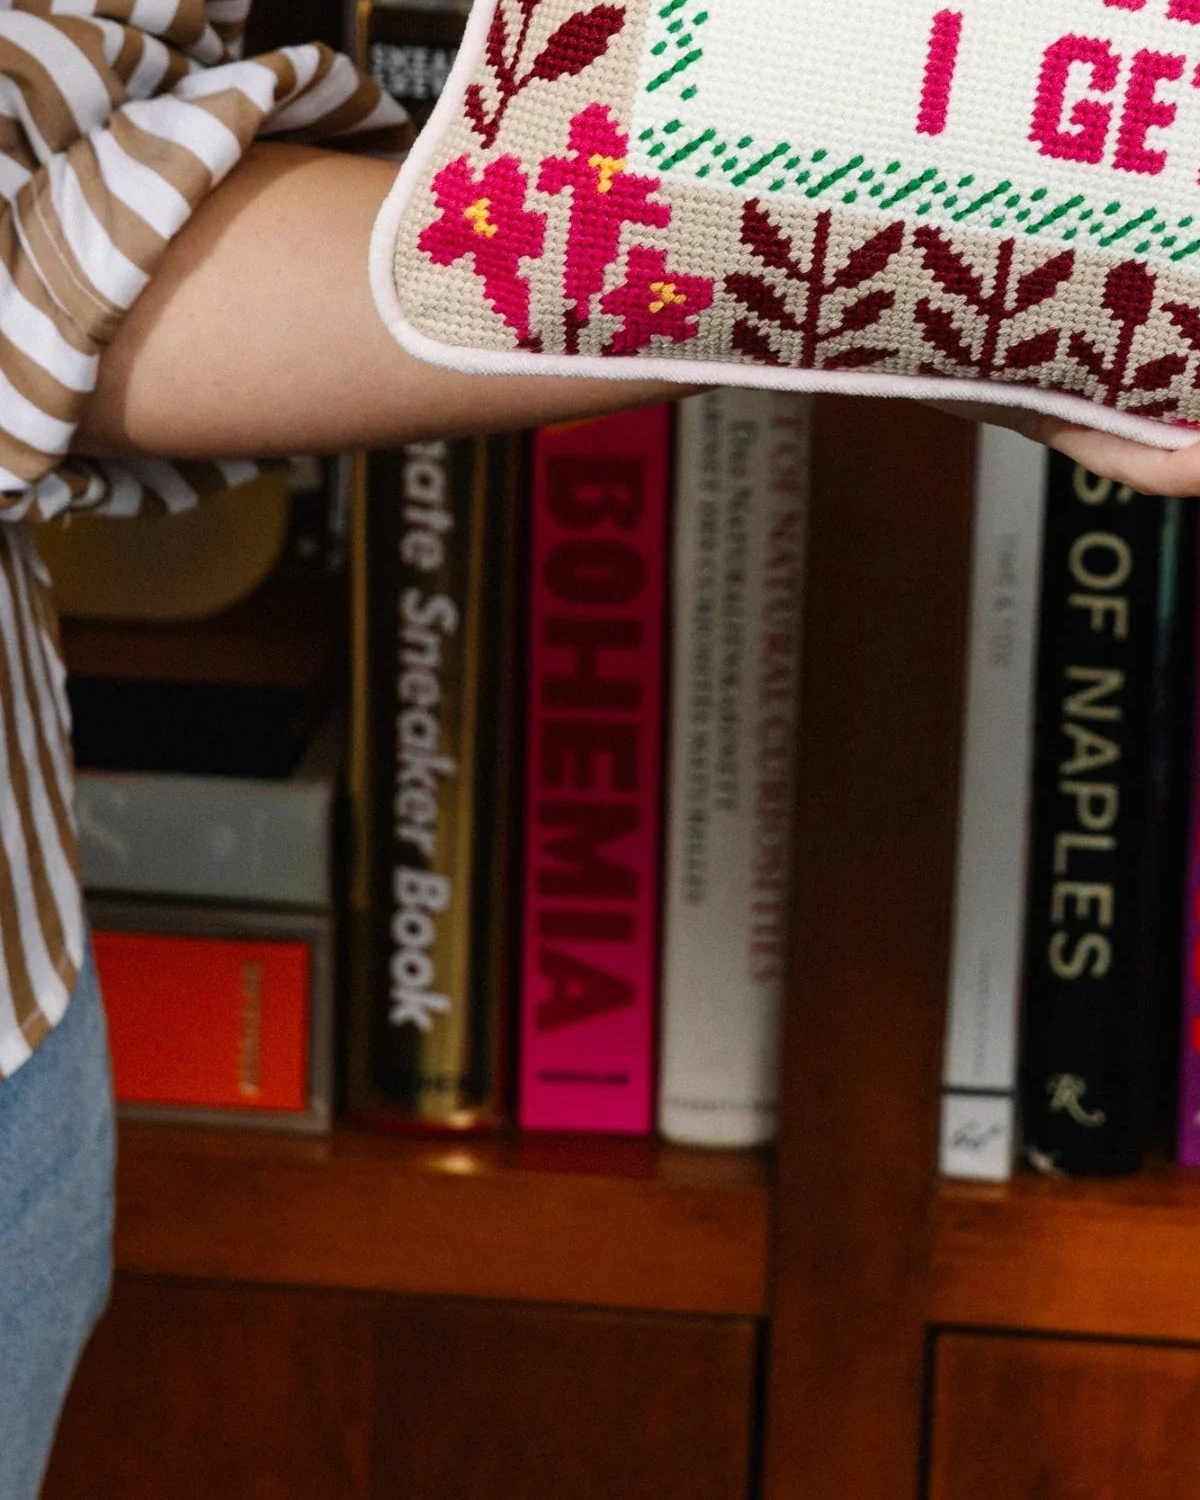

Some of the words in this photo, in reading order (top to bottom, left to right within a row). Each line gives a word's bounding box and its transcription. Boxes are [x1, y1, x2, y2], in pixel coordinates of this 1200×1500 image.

[915, 8, 963, 136] I
[1066, 530, 1134, 641] OF
[394, 586, 457, 858] Sneaker
[535, 454, 650, 1034] BOHEMIA
[1047, 663, 1126, 981] NAPLES
[389, 866, 452, 1032] Book
